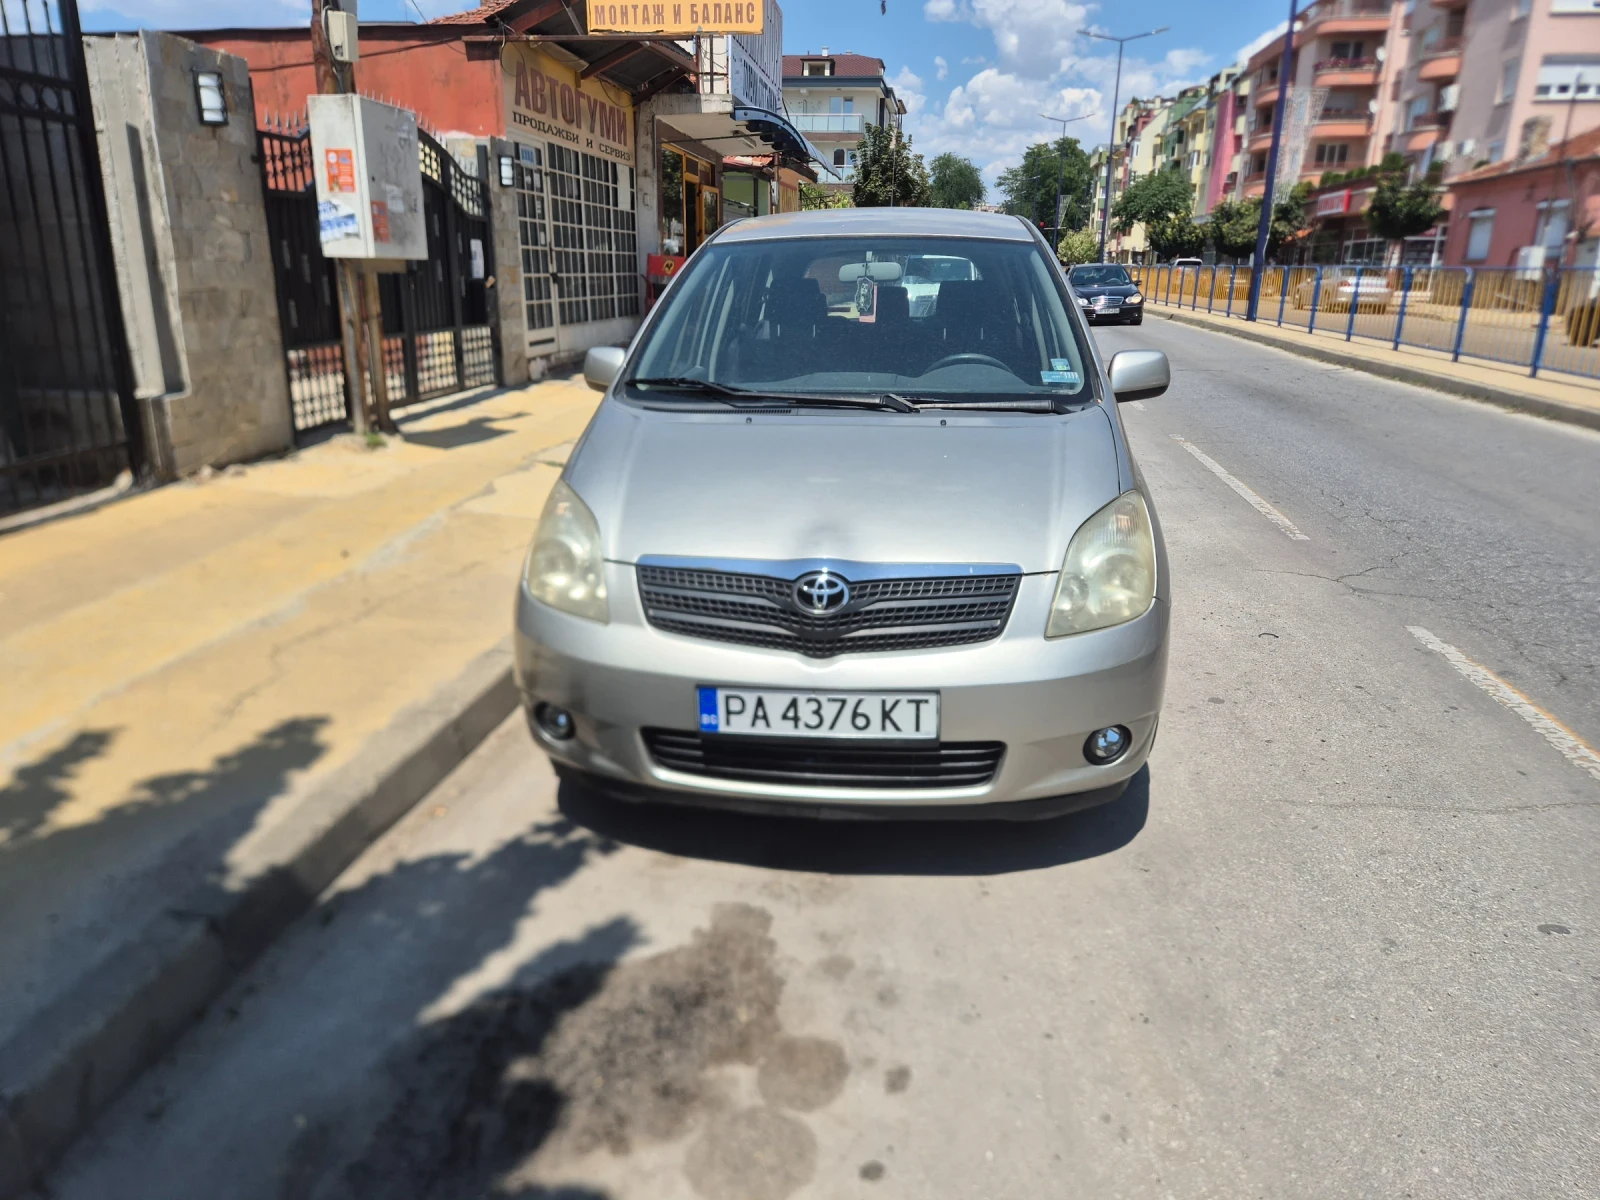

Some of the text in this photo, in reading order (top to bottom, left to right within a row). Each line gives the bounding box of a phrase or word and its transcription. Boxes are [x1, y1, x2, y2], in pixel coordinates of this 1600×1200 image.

[594, 3, 755, 26] МОНТАЖ И БАЛАНС
[514, 60, 628, 147] АВТОГУМИ
[512, 110, 631, 161] ПРОДАЖБИ И СЕРВИЗ
[702, 713, 718, 725] BG
